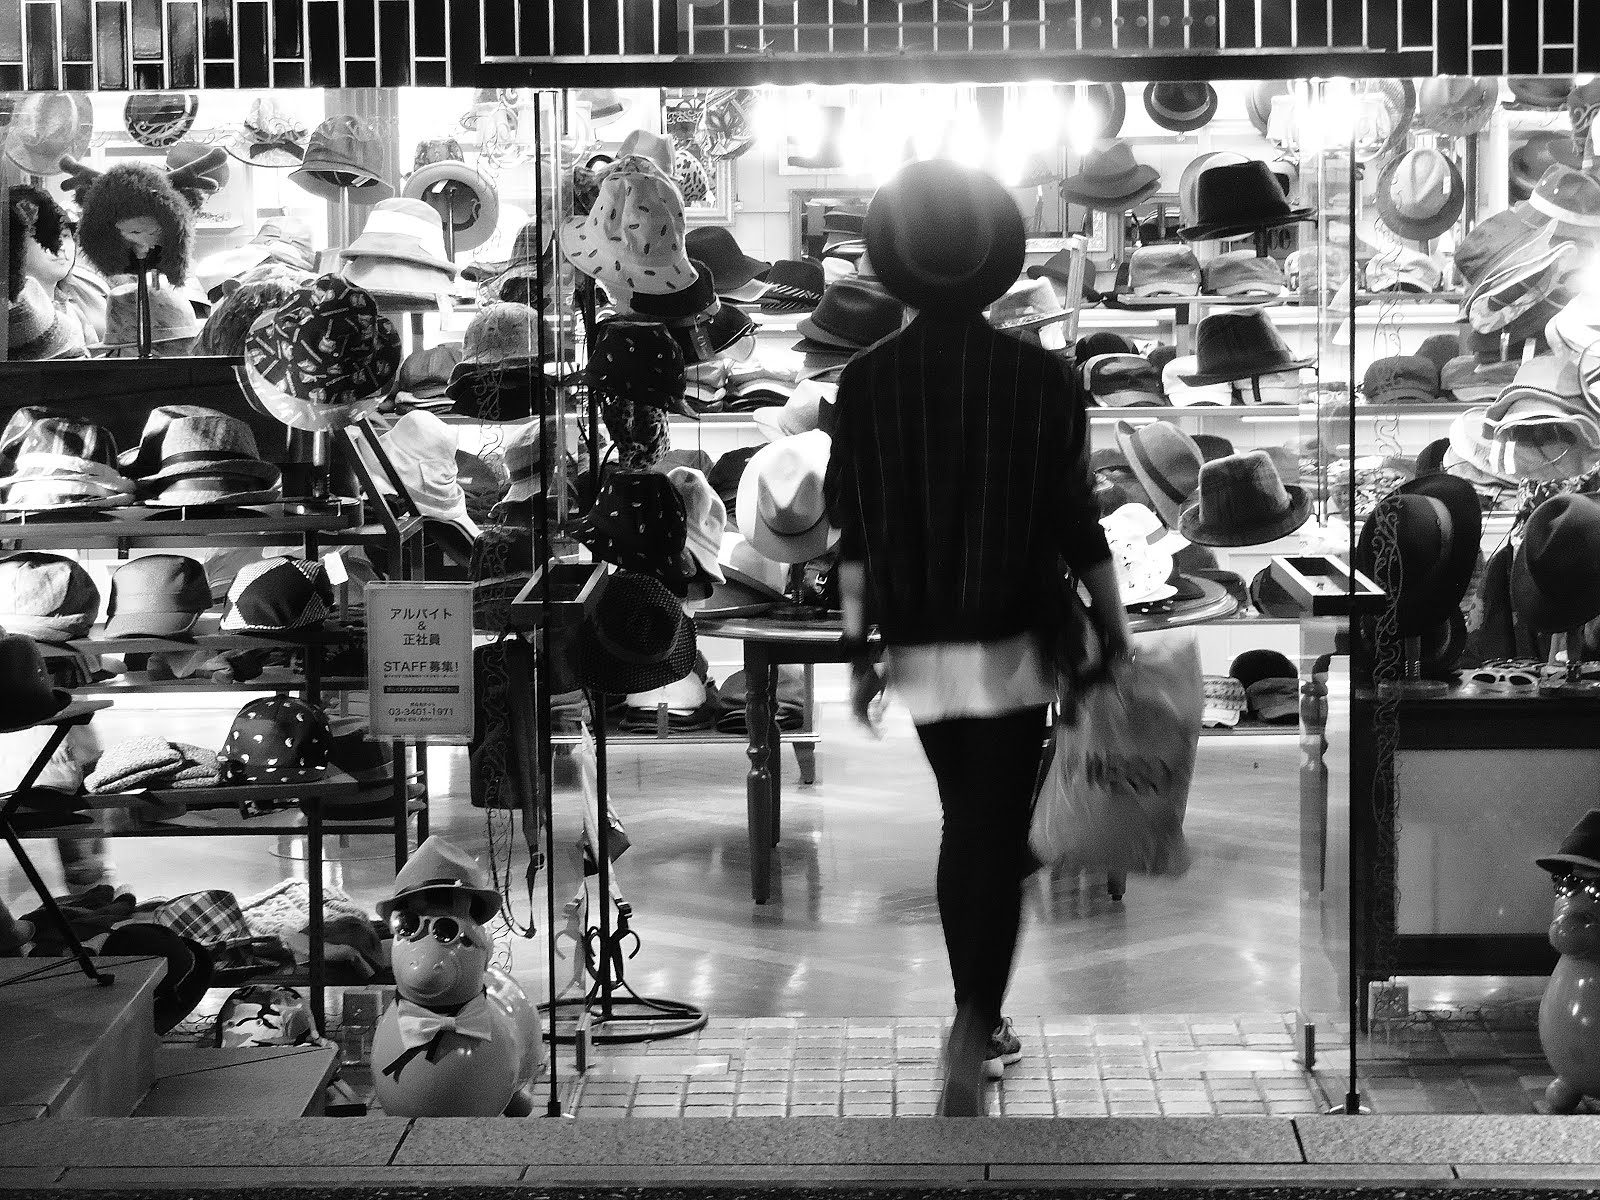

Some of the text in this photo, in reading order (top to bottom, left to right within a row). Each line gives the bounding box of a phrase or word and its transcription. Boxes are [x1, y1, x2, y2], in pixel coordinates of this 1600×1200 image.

[390, 607, 452, 620] アルバイト
[417, 620, 427, 631] &
[402, 633, 441, 646] 正社員
[383, 661, 427, 672] STAFF
